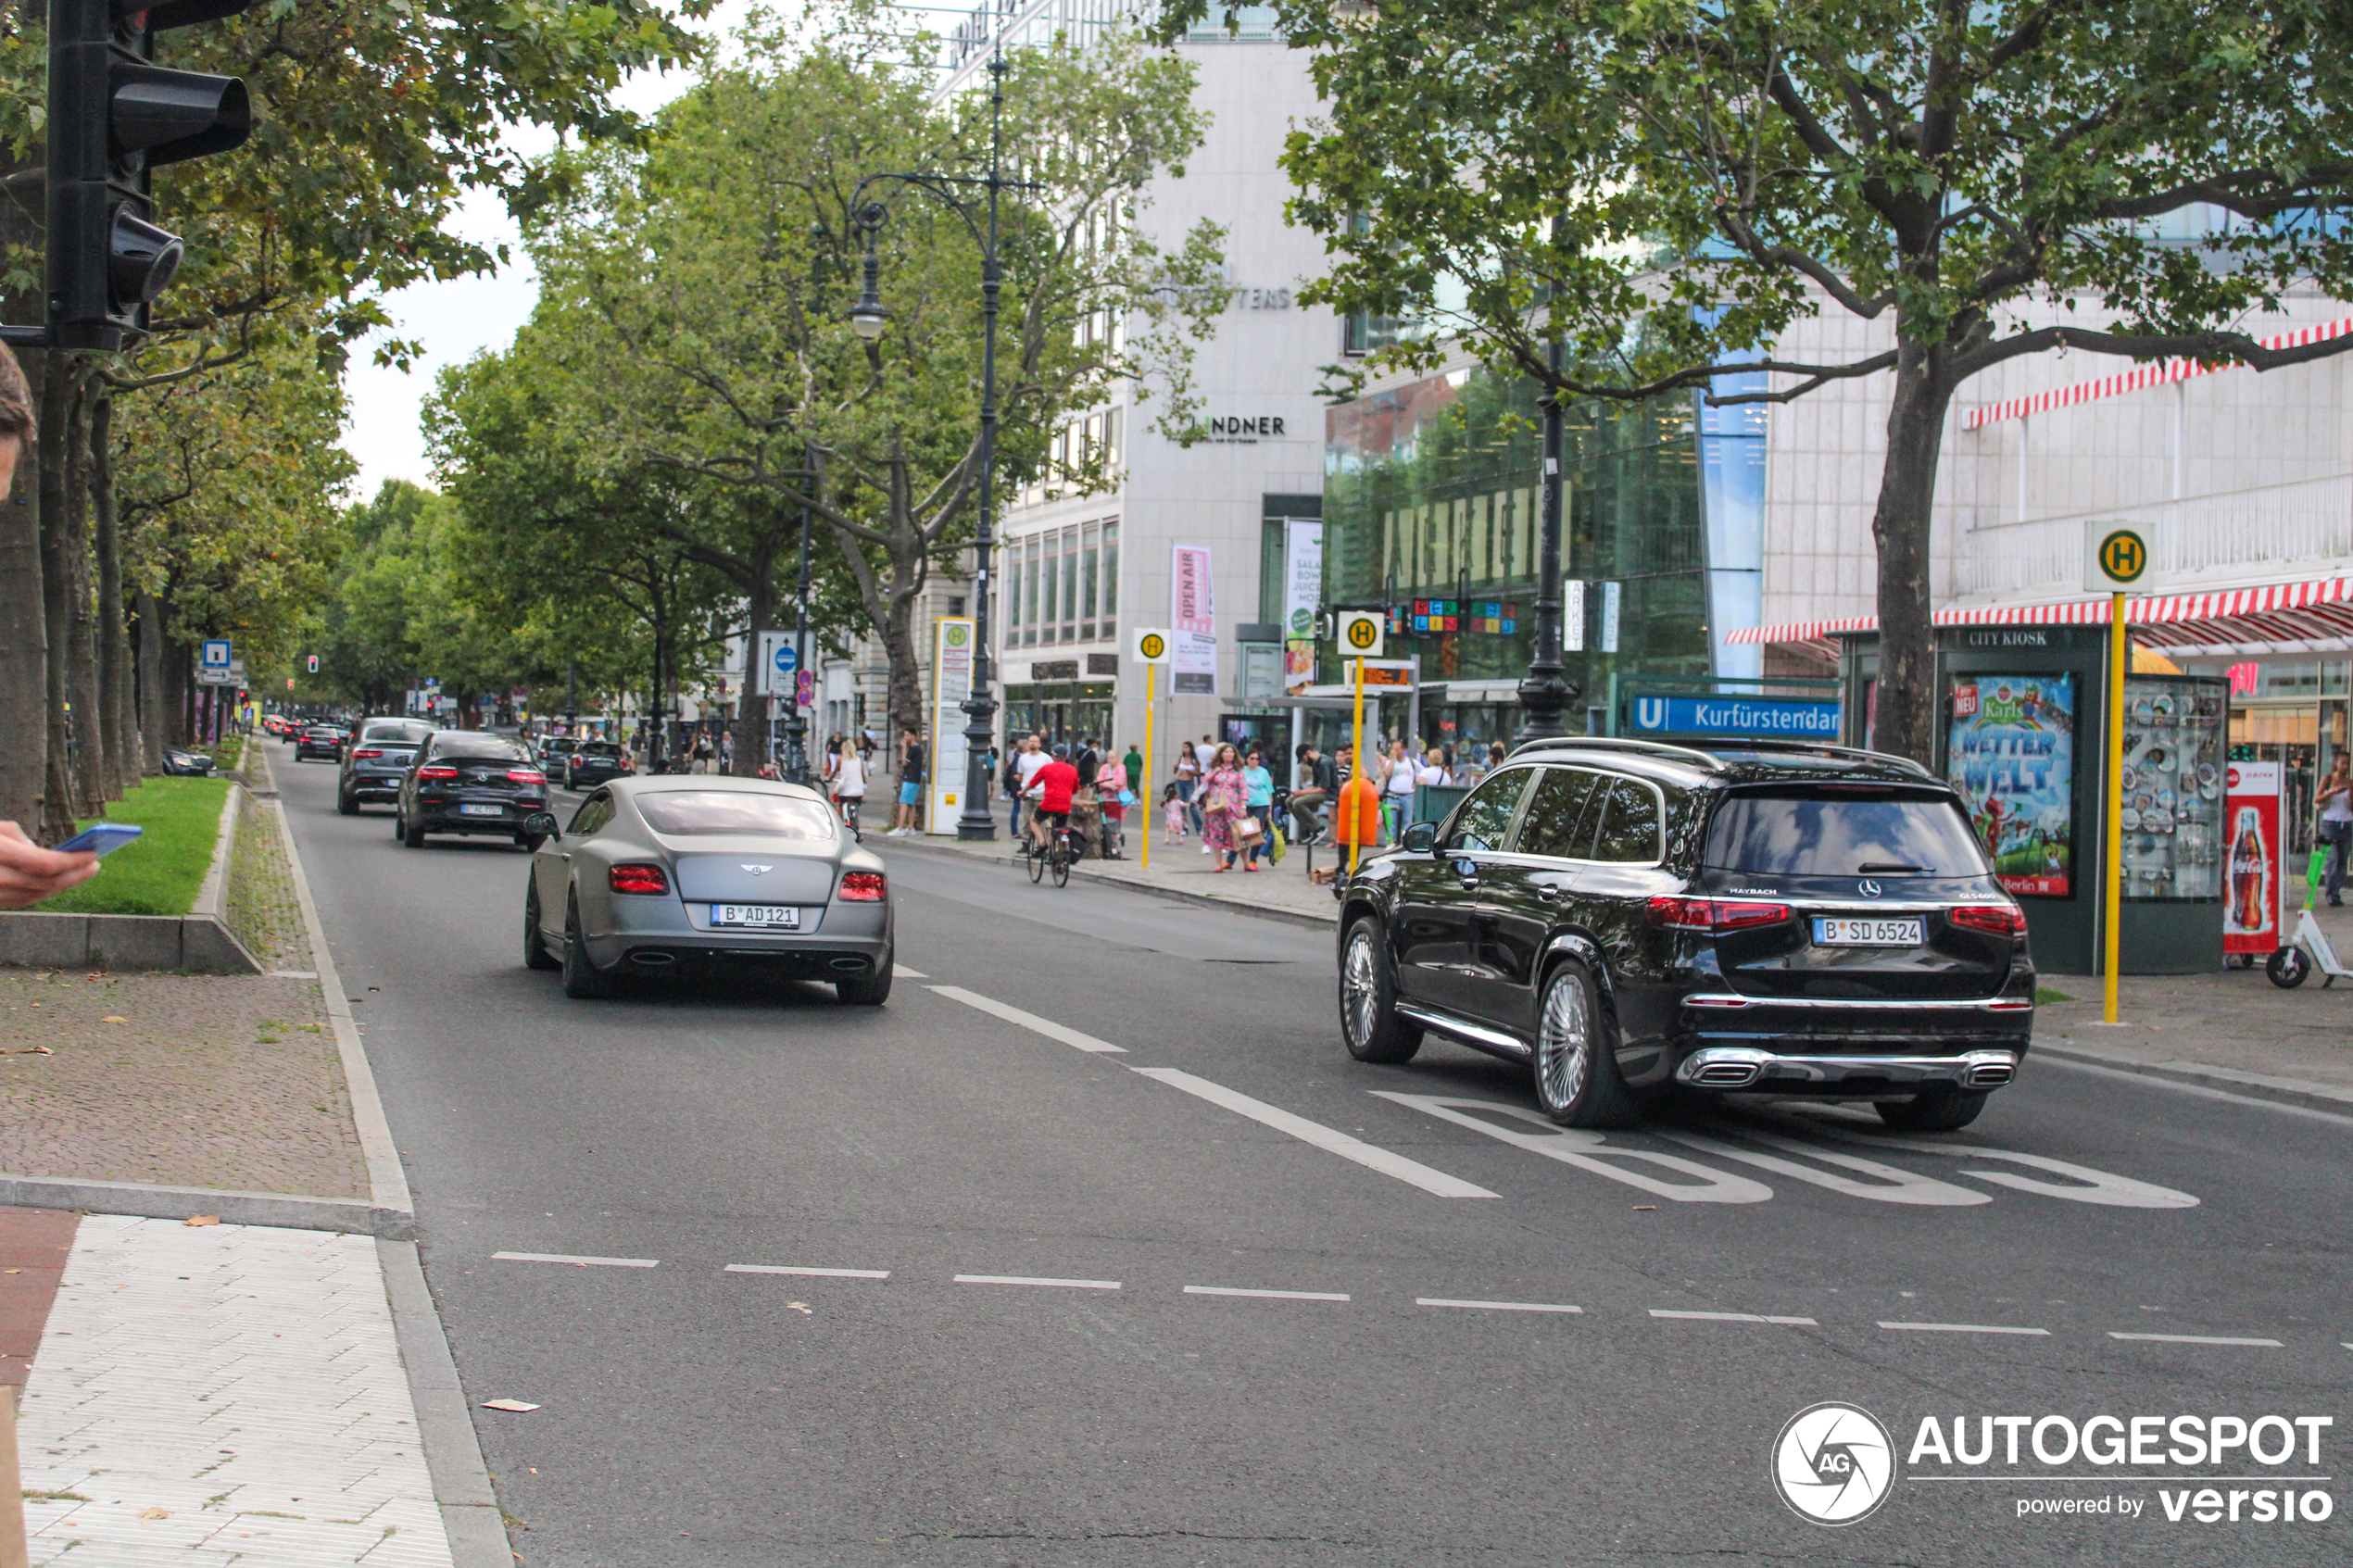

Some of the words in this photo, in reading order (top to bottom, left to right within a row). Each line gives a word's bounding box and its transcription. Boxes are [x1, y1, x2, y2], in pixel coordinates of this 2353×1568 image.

[1182, 553, 1193, 575] AIR
[2113, 542, 2135, 571] H
[1183, 581, 1194, 619] OPEN
[1572, 583, 1581, 648] ARKET
[1356, 625, 1369, 642] H
[1969, 632, 1998, 646] CITY
[2002, 632, 2047, 646] KIOSK
[1147, 639, 1158, 654] H
[1639, 697, 1663, 729] U
[1957, 699, 1976, 715] NEU
[1985, 701, 2024, 719] Karls
[1962, 731, 2057, 757] WETTER
[1964, 759, 2054, 795] WELT
[2004, 878, 2035, 892] Berlin
[726, 907, 736, 921] B
[746, 908, 763, 921] AD
[766, 909, 793, 922] 121
[1826, 922, 1836, 939] B
[1850, 922, 1871, 940] SD
[1876, 923, 1919, 941] 6524
